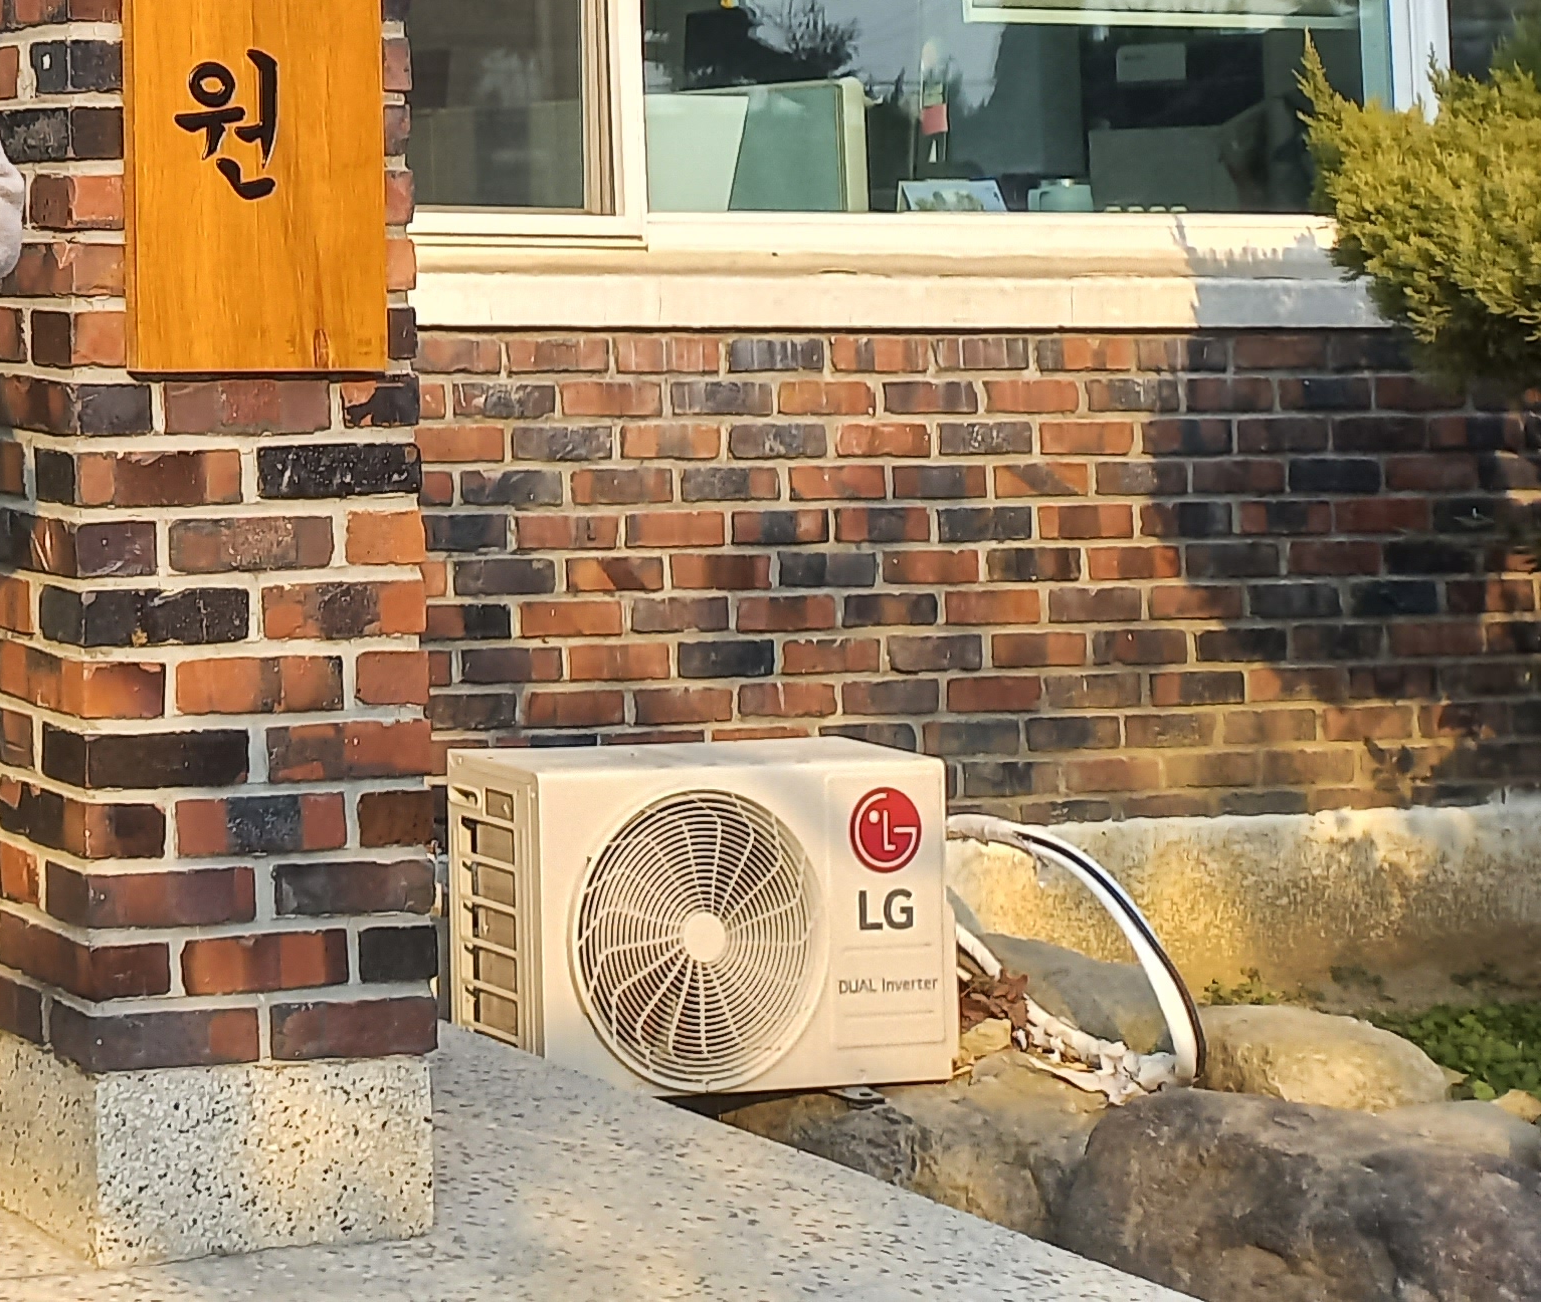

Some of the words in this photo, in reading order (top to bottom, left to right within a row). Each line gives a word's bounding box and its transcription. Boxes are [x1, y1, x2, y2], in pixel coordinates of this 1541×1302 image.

[858, 888, 915, 931] LG
[838, 979, 877, 995] DUAL
[882, 978, 939, 993] Inverter
